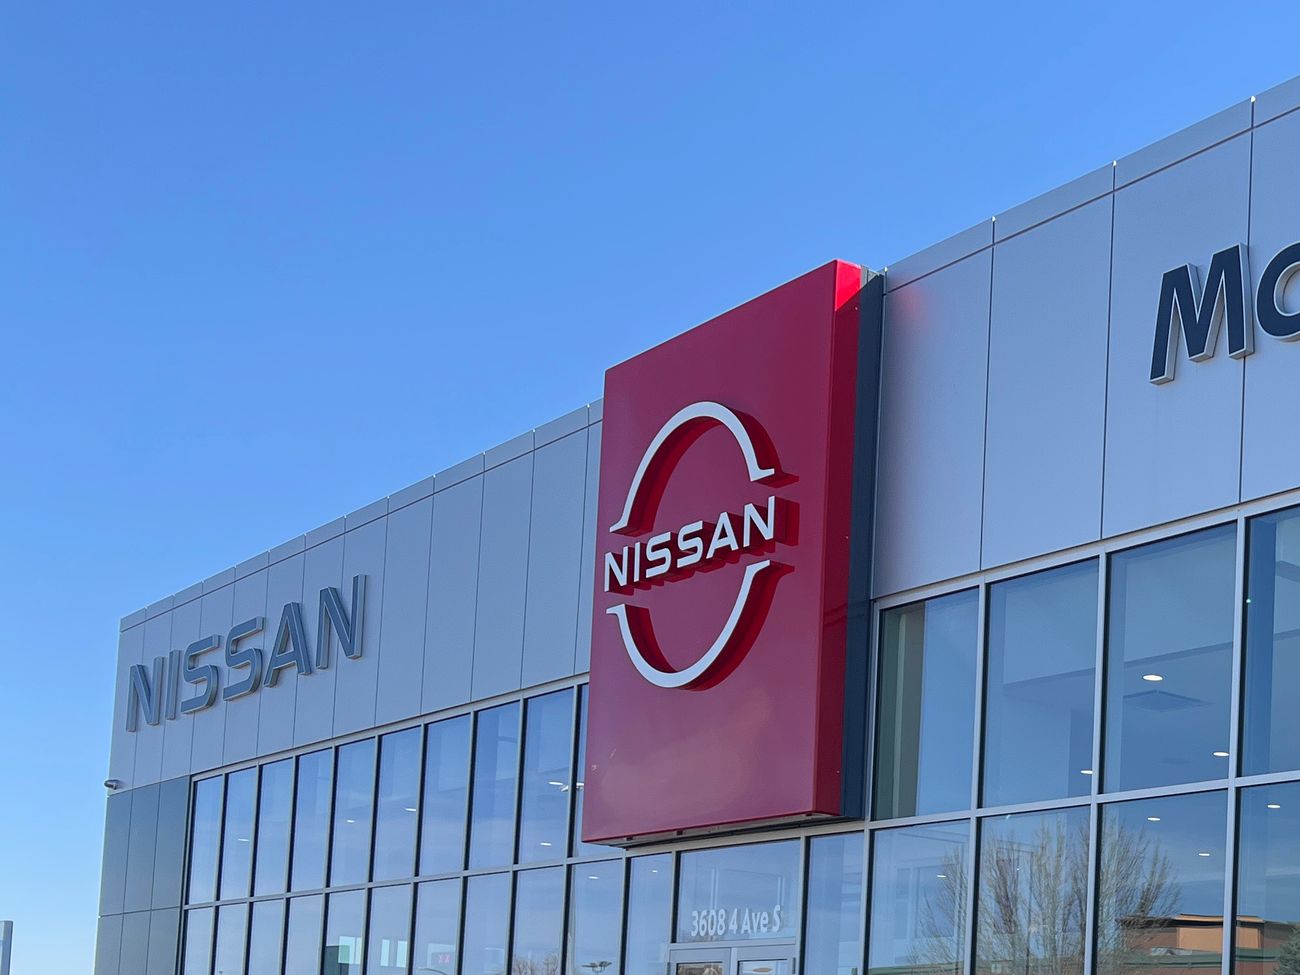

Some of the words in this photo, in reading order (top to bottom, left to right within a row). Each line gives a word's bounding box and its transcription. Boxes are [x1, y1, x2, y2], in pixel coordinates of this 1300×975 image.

[604, 495, 775, 592] NISSAN
[125, 573, 367, 732] NISSAN
[690, 908, 726, 937] 3608
[728, 907, 738, 934] 4
[740, 907, 769, 934] Ave
[771, 904, 781, 933] S
